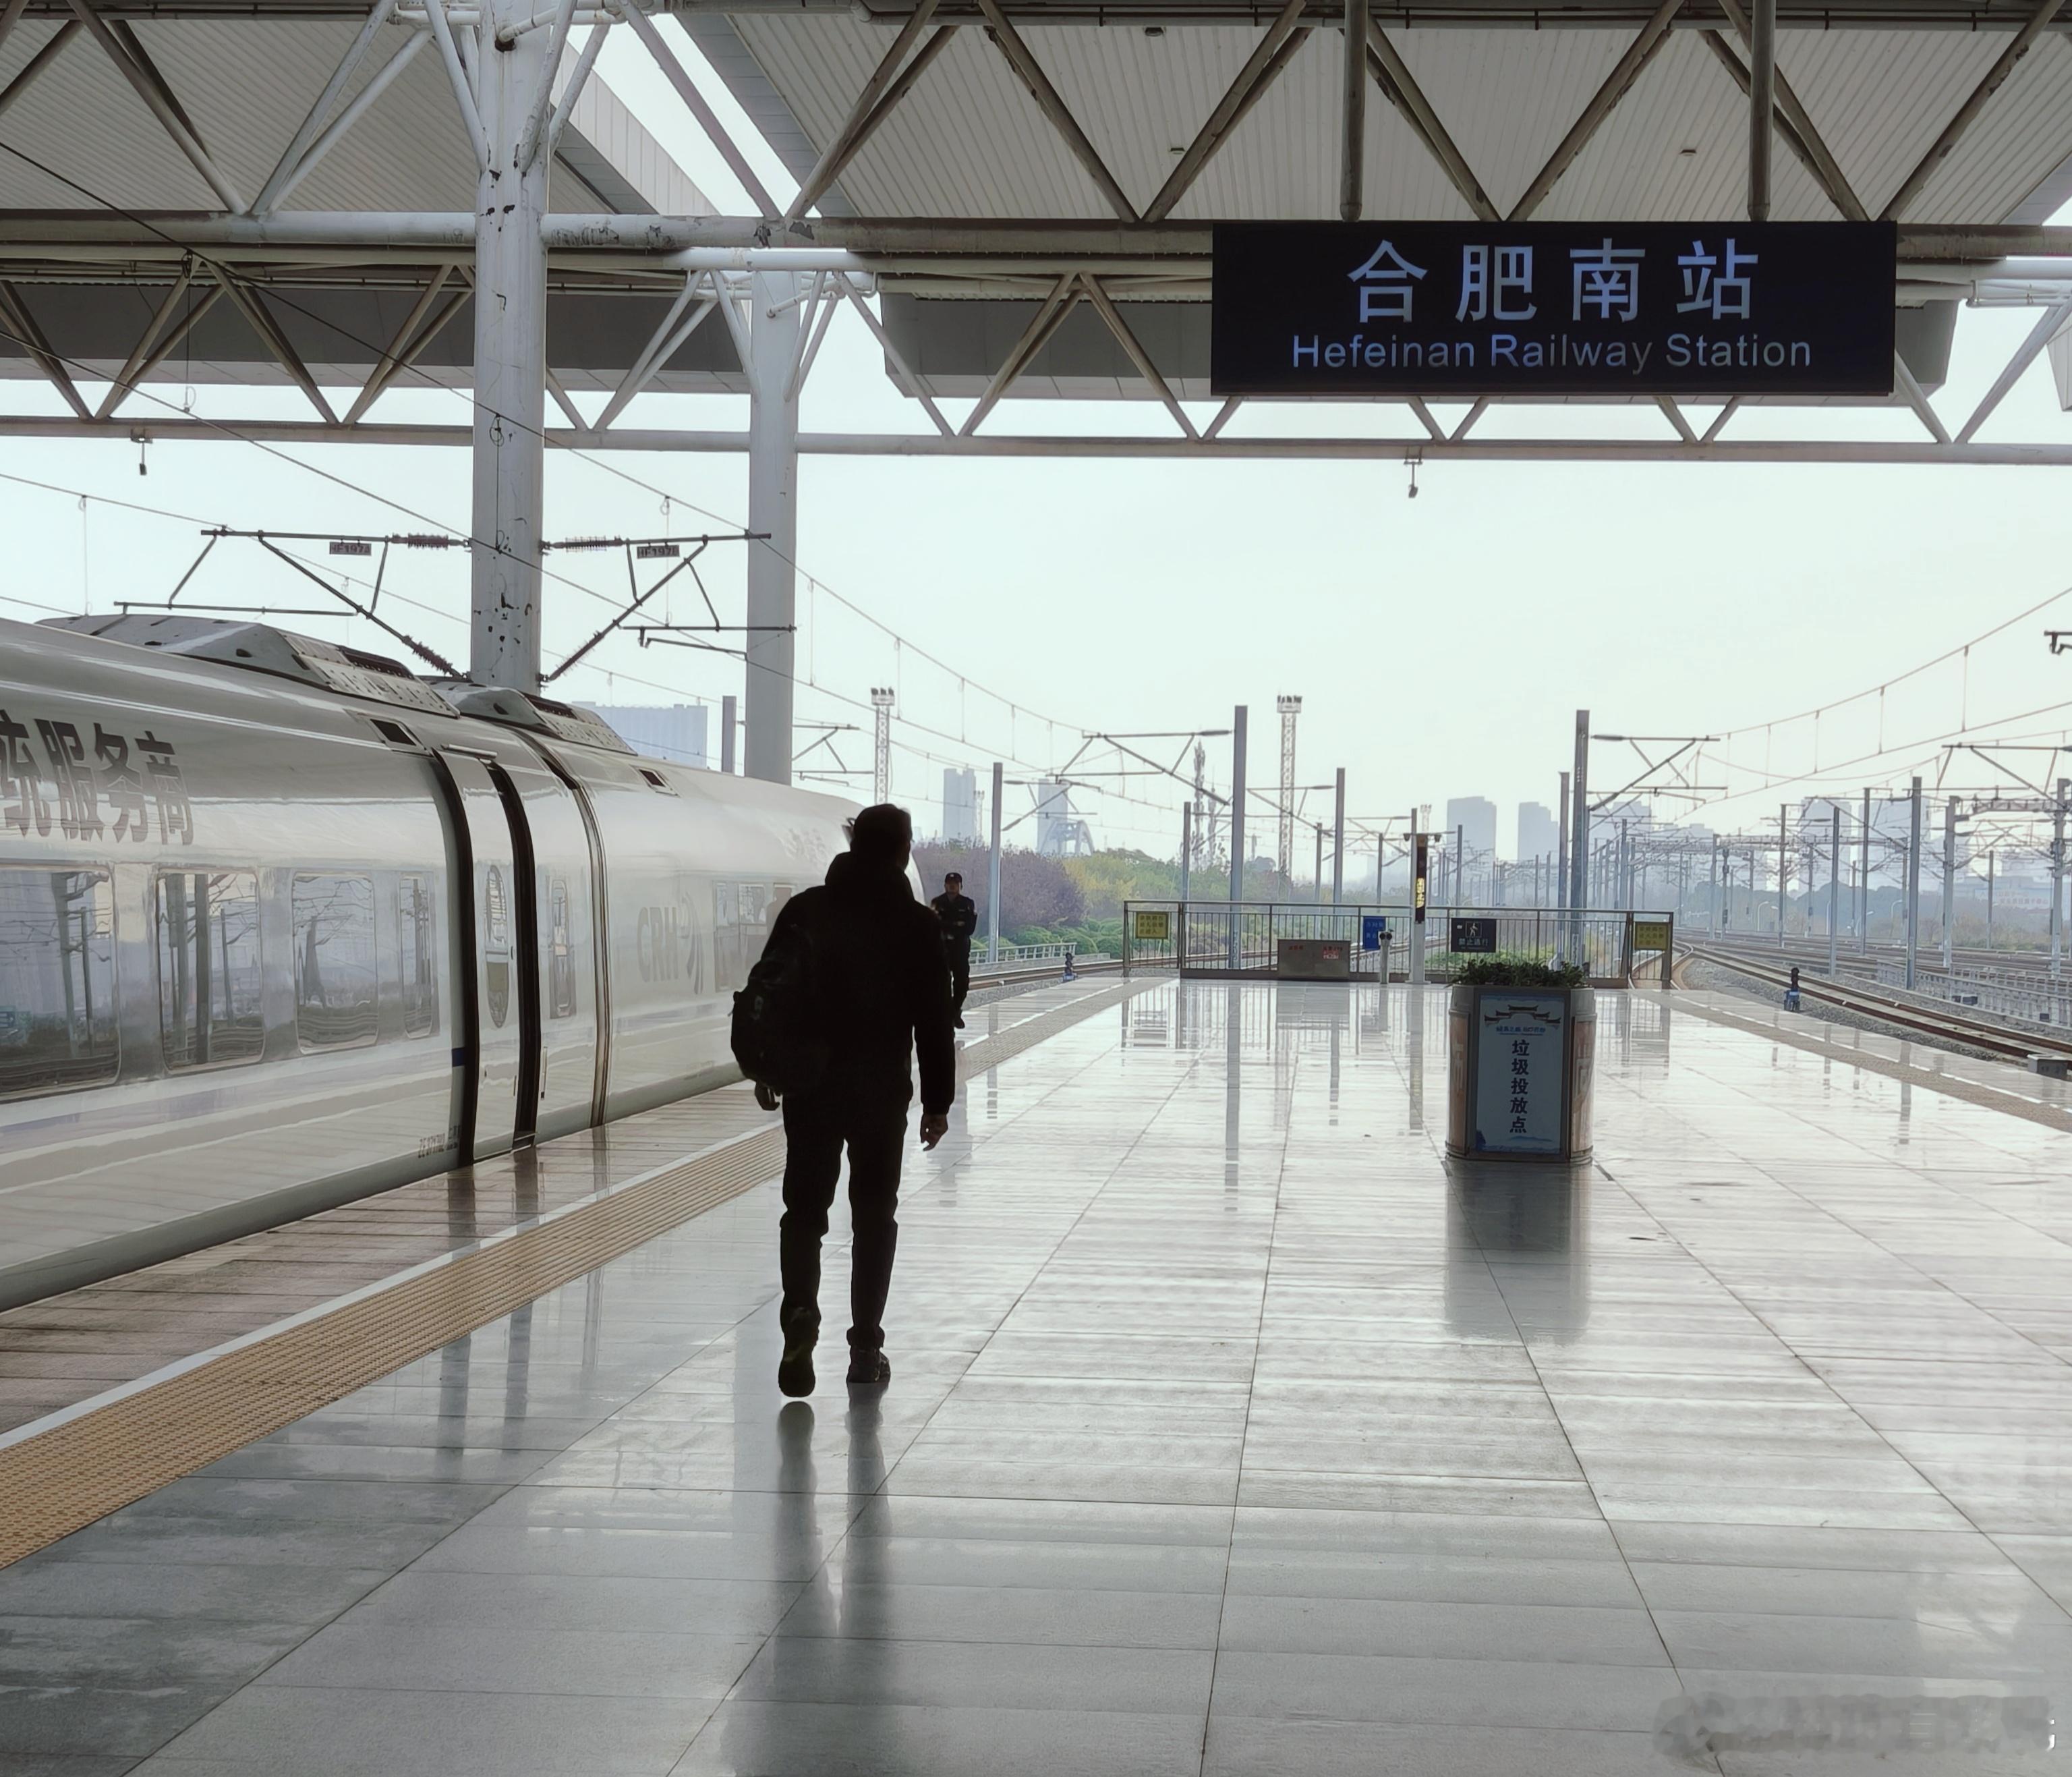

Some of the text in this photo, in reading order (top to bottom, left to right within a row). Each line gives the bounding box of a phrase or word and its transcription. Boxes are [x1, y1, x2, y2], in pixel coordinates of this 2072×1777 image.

[1348, 239, 1758, 322] 合肥南站
[1294, 334, 1810, 373] Hefeinan Railway Station
[637, 907, 678, 982] CRH
[1509, 1040, 1530, 1133] 垃圾投放点
